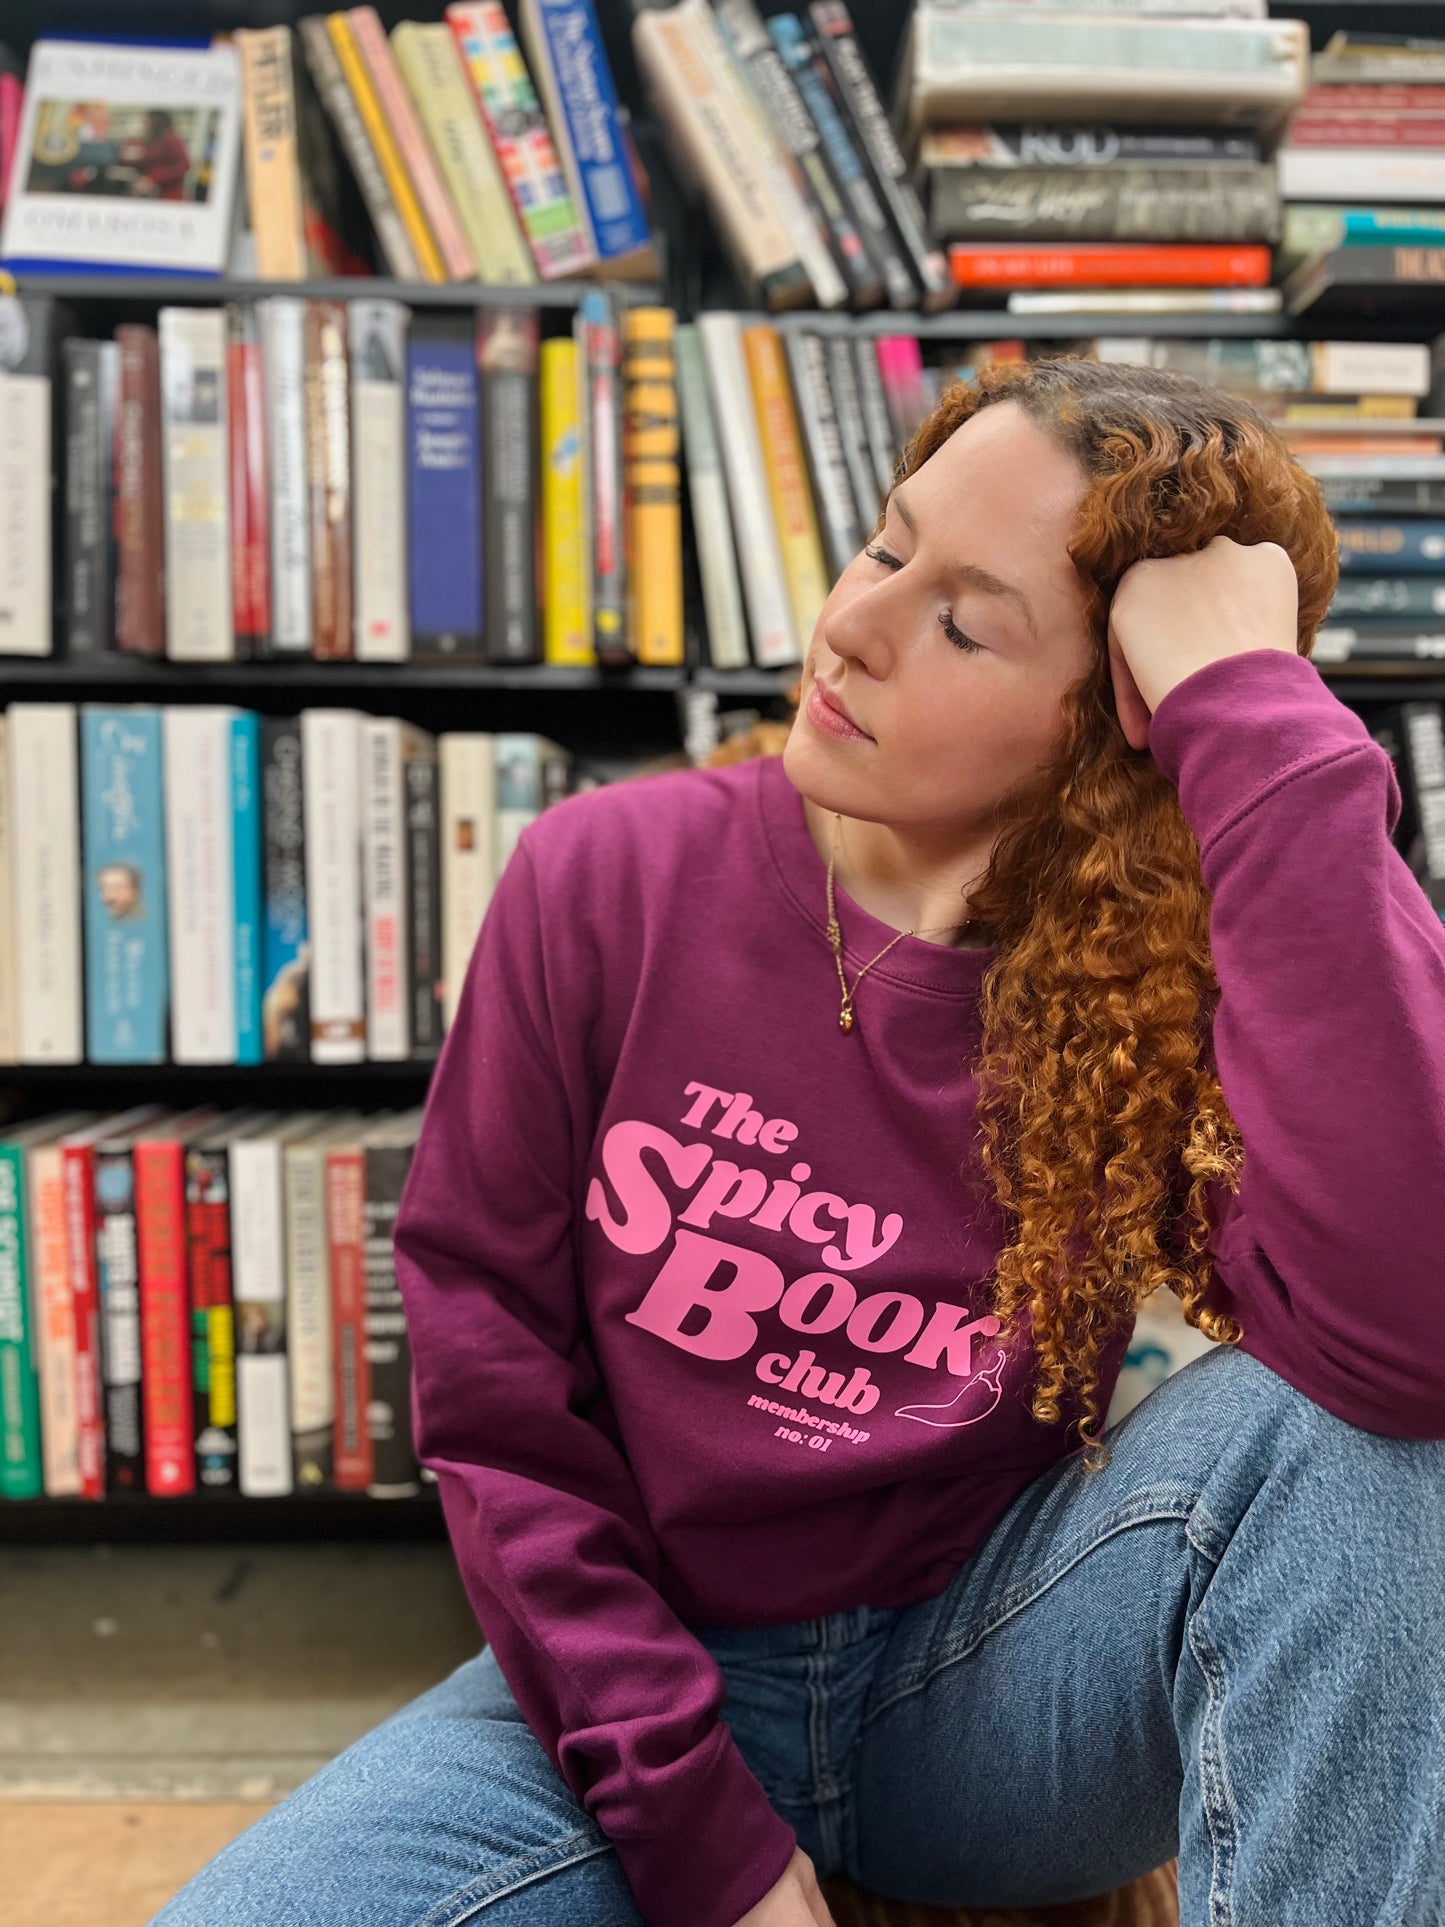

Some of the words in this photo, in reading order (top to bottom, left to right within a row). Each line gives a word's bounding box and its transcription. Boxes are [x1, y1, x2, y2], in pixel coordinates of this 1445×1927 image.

[680, 1081, 799, 1154] The
[585, 1119, 904, 1271] Spicy
[755, 1350, 881, 1415] club
[747, 1394, 871, 1445] membership
